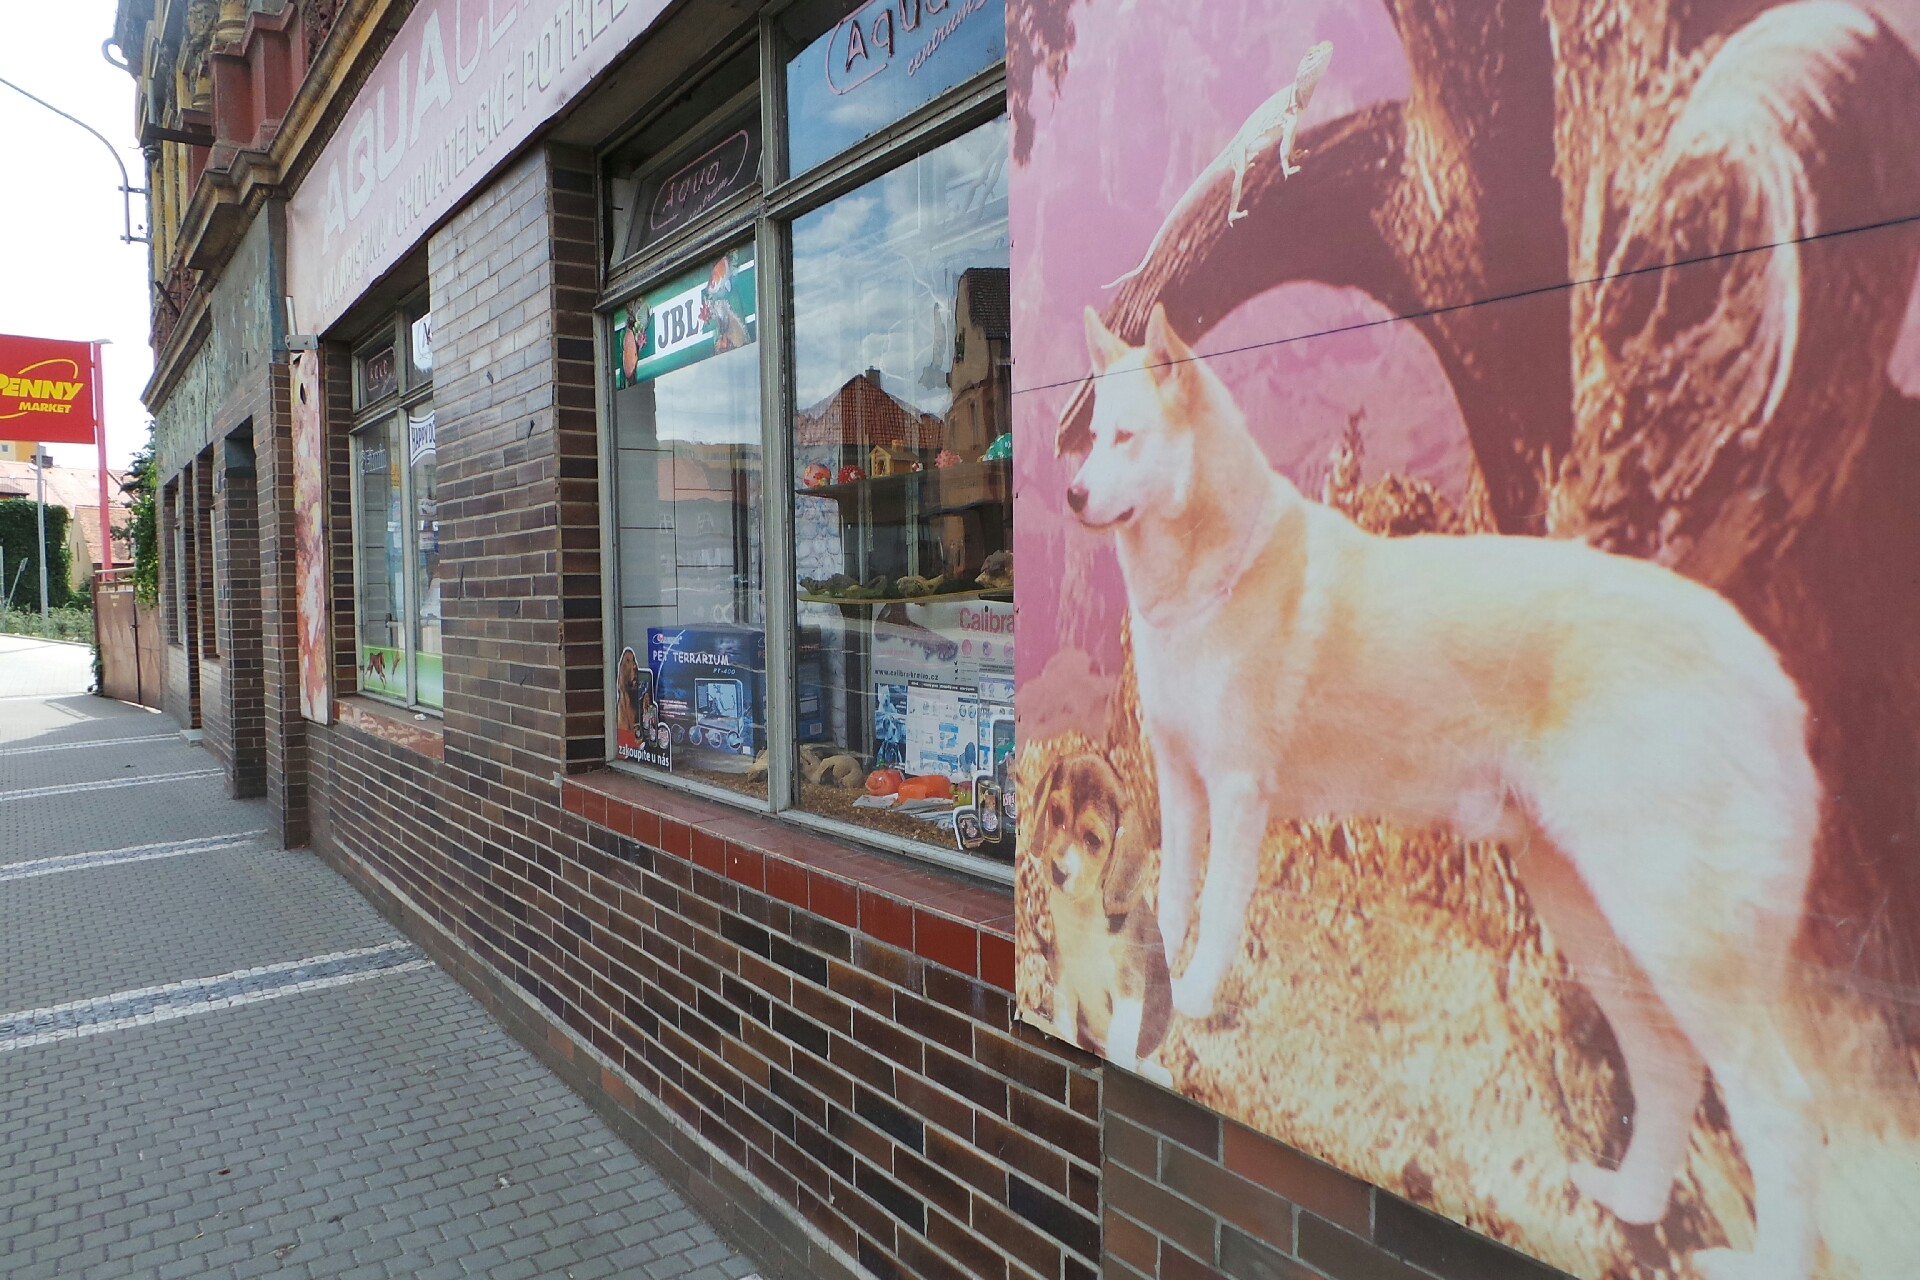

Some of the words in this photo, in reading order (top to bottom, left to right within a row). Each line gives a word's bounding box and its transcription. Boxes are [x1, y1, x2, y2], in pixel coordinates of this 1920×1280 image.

[322, 0, 530, 256] AQUAC
[395, 42, 516, 238] CHOVATELSKÉ
[657, 299, 700, 349] JBL
[18, 401, 72, 414] MARKET
[959, 605, 1014, 634] Calibra
[652, 650, 667, 662] PET
[672, 652, 730, 666] TERRARIUM
[618, 743, 651, 762] zakoupite
[651, 753, 657, 763] u
[657, 752, 670, 767] nás
